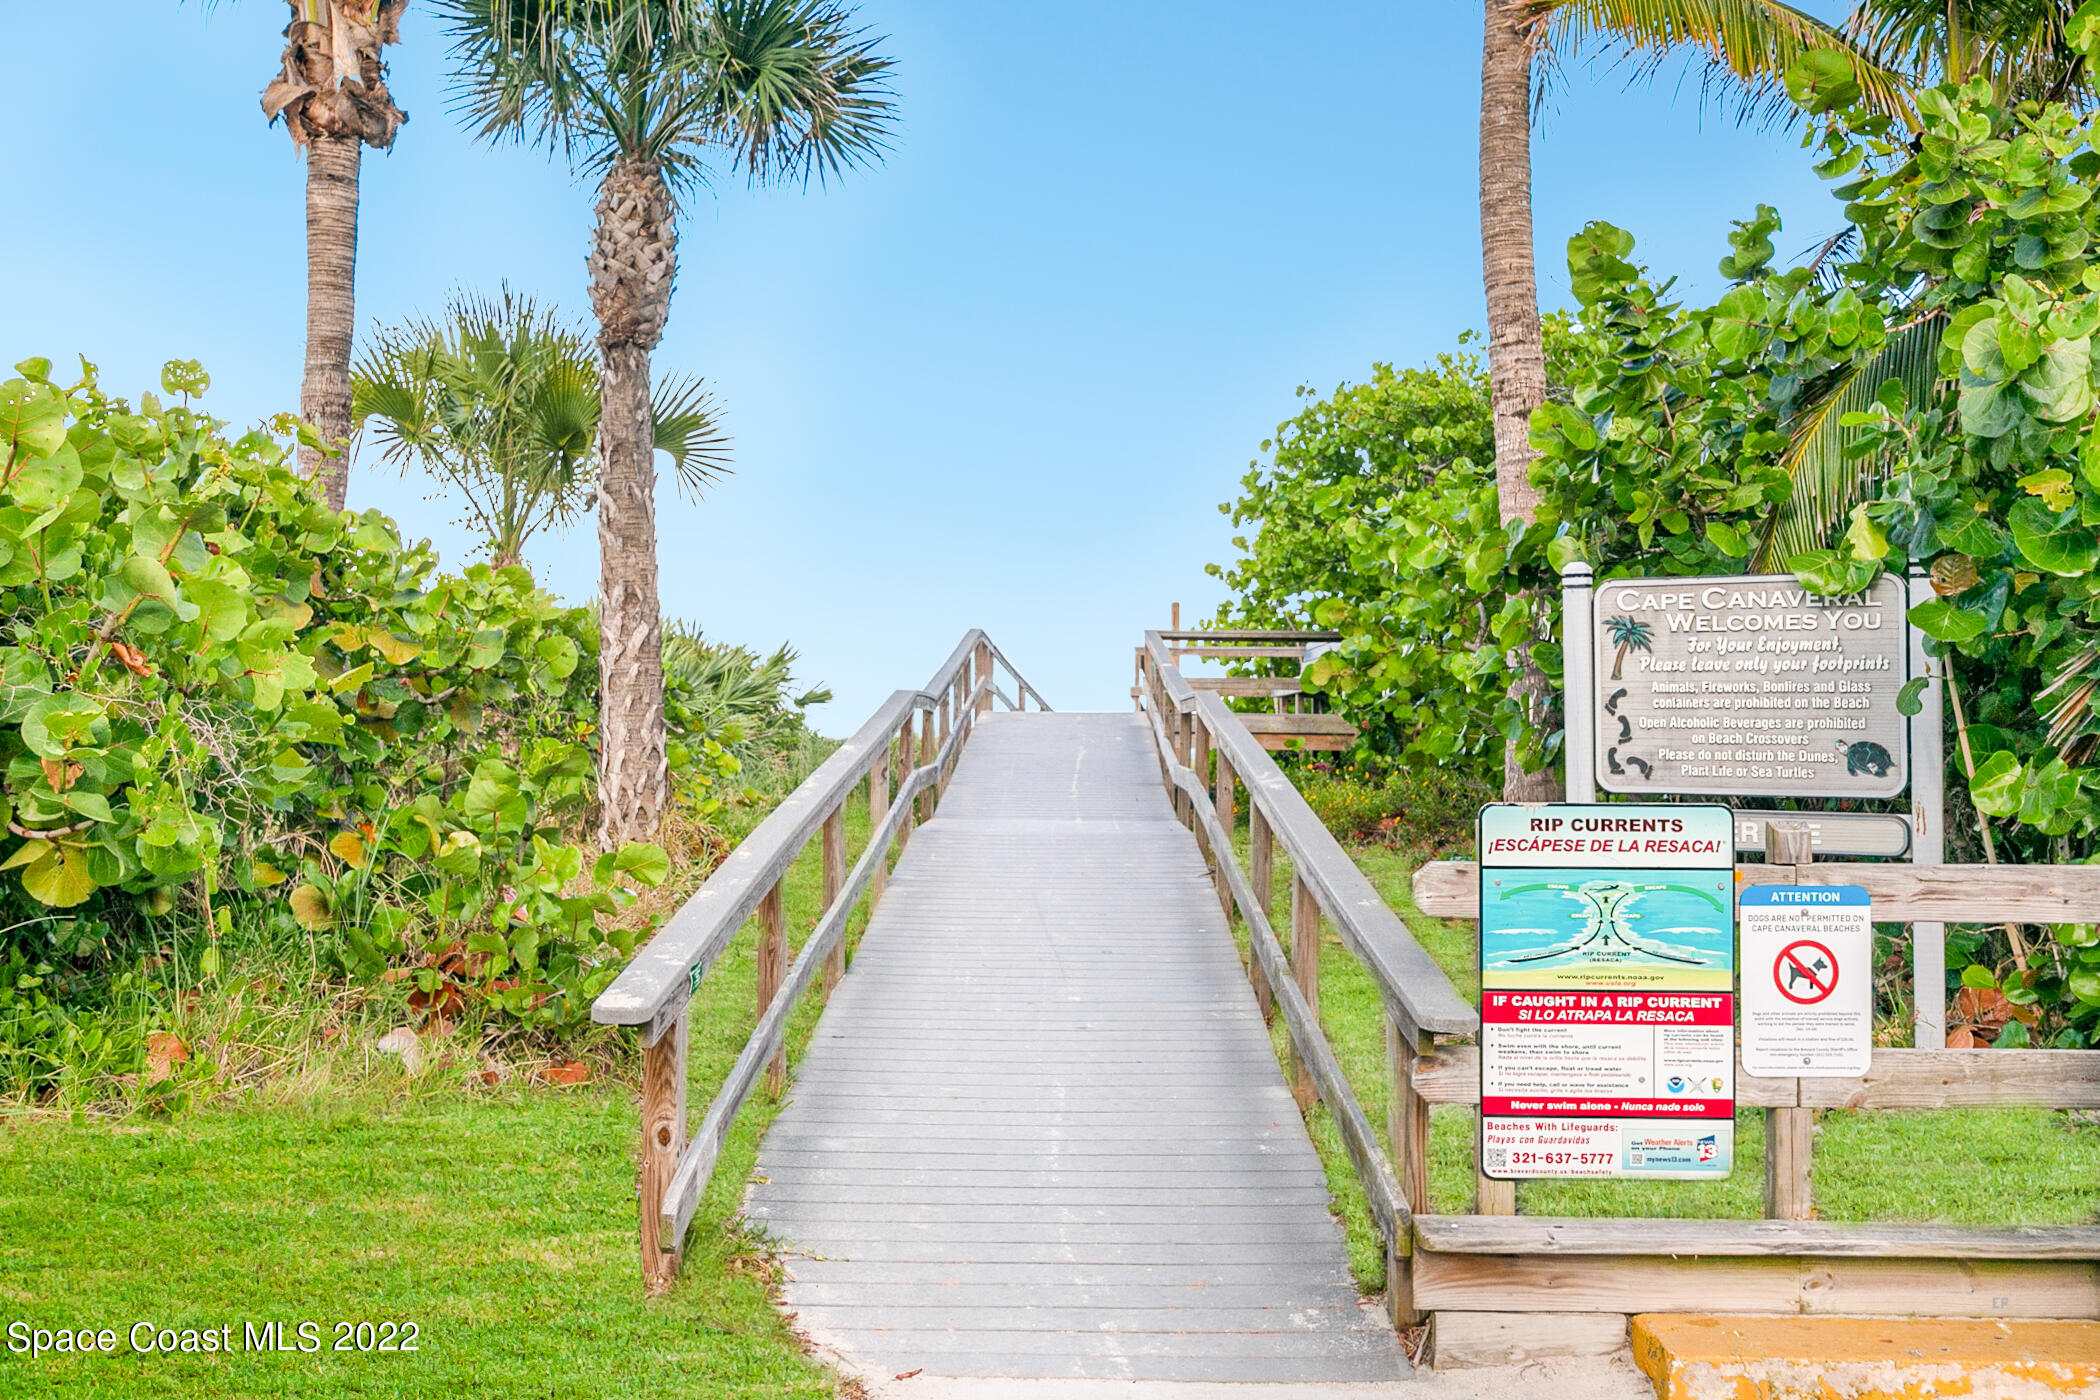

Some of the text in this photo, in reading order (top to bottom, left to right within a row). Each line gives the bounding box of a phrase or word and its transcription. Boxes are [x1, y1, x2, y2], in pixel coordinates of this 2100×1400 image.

[1617, 590, 1695, 611] CAPE
[1667, 610, 1881, 632] WELCOMES YOU
[1688, 636, 1842, 655] For Your Enjoyment,
[1641, 655, 1890, 674] Please leave only your footprints
[1652, 681, 1871, 694] Animals, Fireworks, Bonfires and Glass
[1653, 697, 1869, 711] containers are prohibited on the Beach
[1639, 717, 1865, 731] Open Alcoholic Beverages are prohibited
[1692, 733, 1808, 745] on Beach Crossovers
[1659, 750, 1838, 764] Please do not disturb the Dunes,
[1682, 765, 1814, 779] Plant Life or Sea Turtles
[1531, 818, 1683, 832] RIP CURRENTS
[1488, 836, 1720, 854] ¡ESCÁPESE DE LA RESACA!
[1771, 892, 1840, 902] ATTENTION
[1493, 996, 1722, 1008] IF CAUGHT IN A RIP CURRENT
[1519, 1010, 1694, 1021] SI LO ATRAPA LA RESACA
[1511, 1101, 1544, 1110] Never
[1547, 1101, 1577, 1110] swim
[1580, 1101, 1611, 1110] alone
[1621, 1102, 1653, 1111] Nunca
[1656, 1102, 1680, 1111] nade
[1683, 1103, 1705, 1112] solo
[1487, 1122, 1618, 1133] Beaches With Lifeguards:
[1488, 1135, 1516, 1145] Playas
[1539, 1136, 1590, 1145] Guardavidas
[1513, 1153, 1613, 1164] 321-637-5777
[1699, 1144, 1718, 1159] 13
